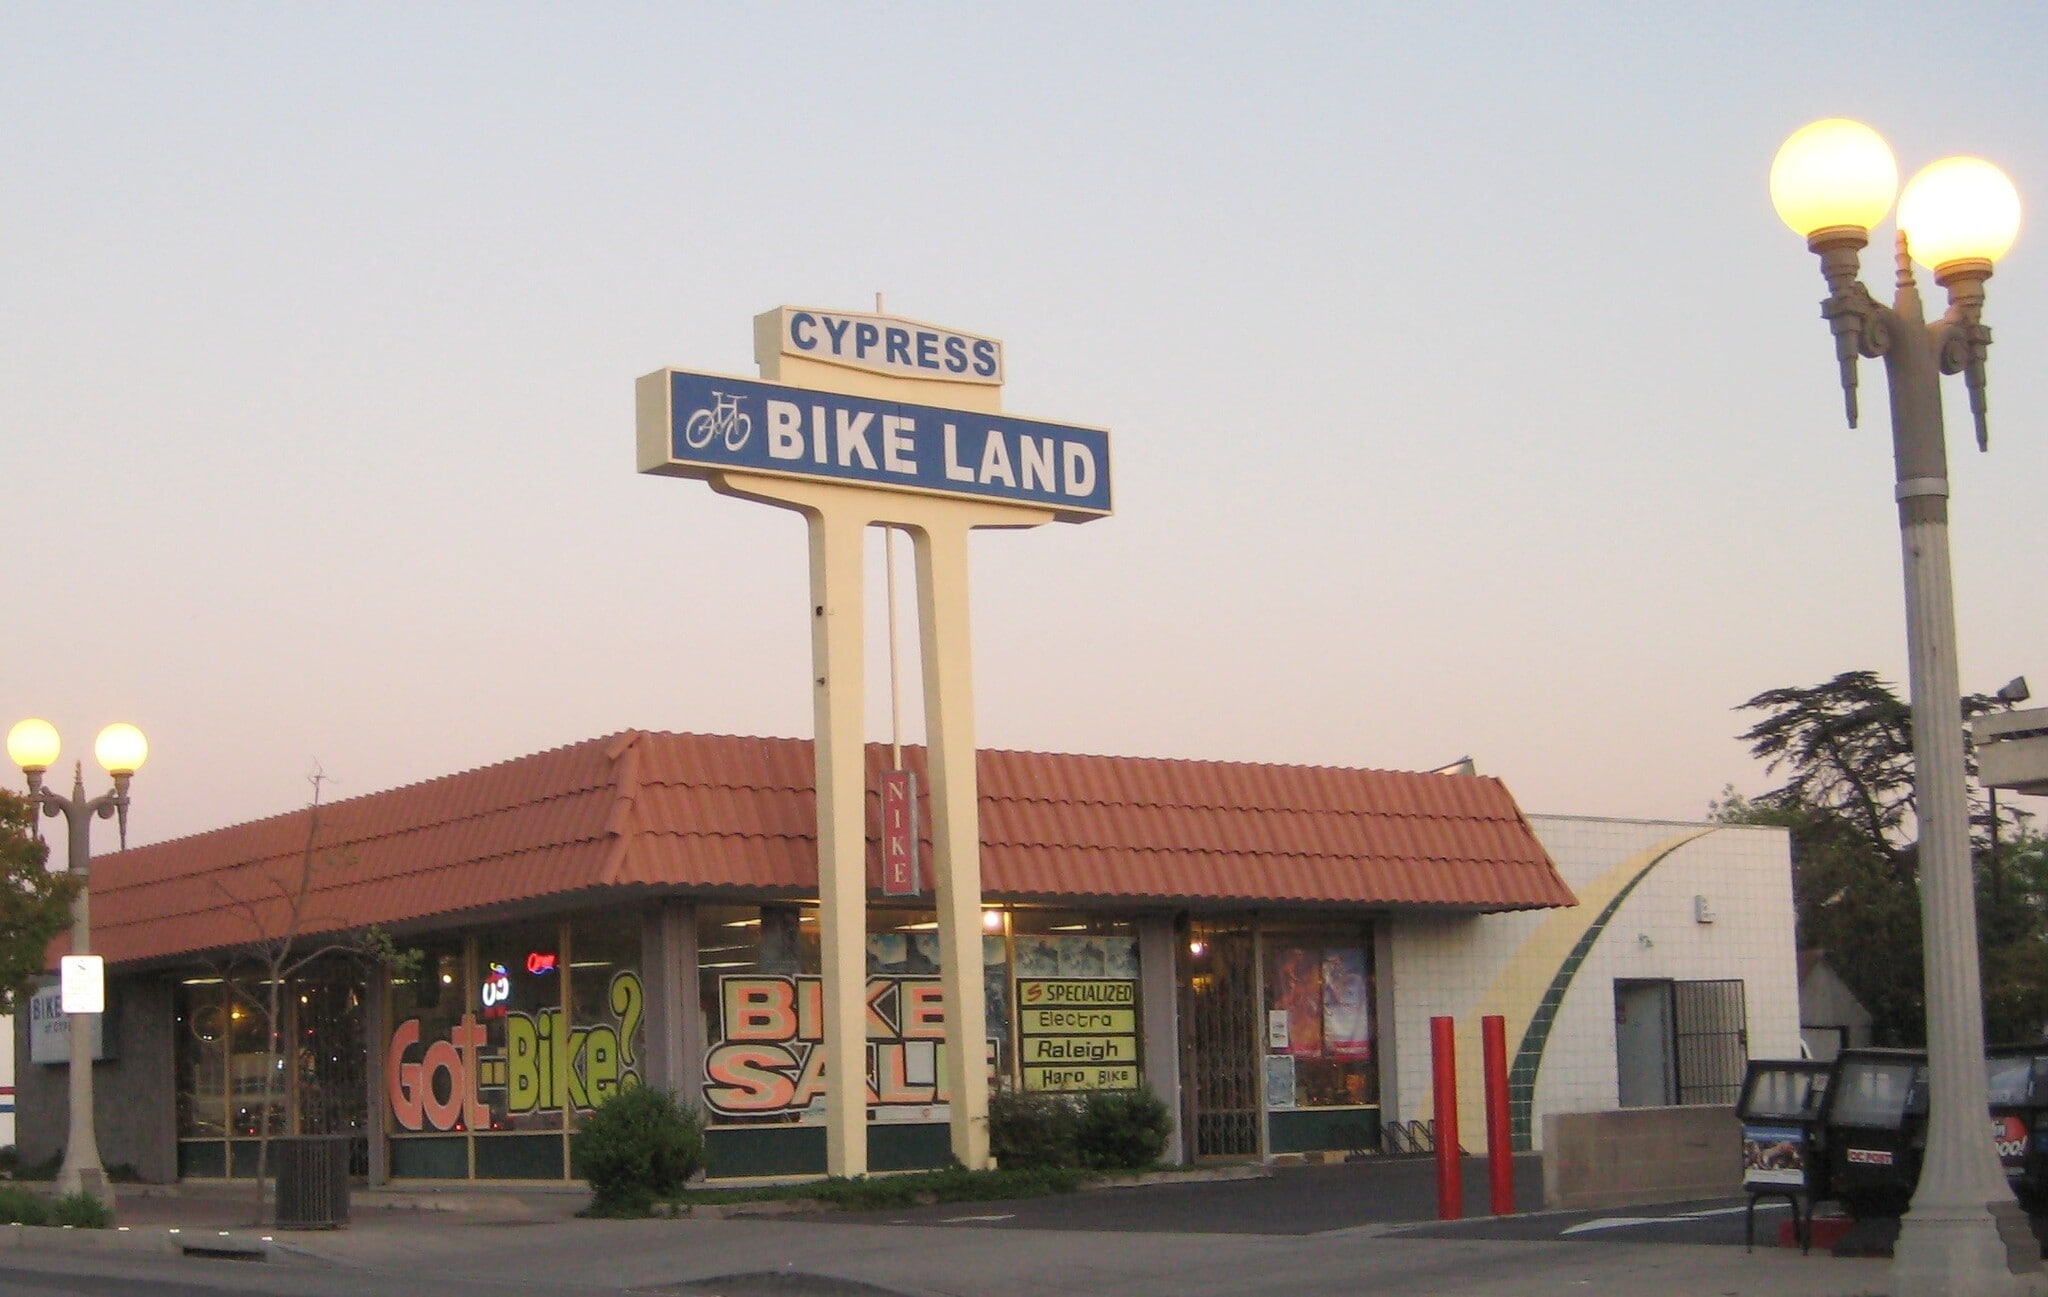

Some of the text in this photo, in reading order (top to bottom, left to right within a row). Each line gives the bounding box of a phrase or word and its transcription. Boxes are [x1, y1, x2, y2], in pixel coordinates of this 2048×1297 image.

[790, 312, 997, 378] CYPRESS
[766, 399, 1097, 498] BIKE LAND
[888, 781, 906, 883] NIKE
[1046, 984, 1132, 1002] SPECIALIZED
[1039, 1011, 1112, 1028] Electra
[389, 1013, 491, 1131] Got
[1037, 1040, 1119, 1061] Raleigh
[1042, 1069, 1085, 1088] Haro
